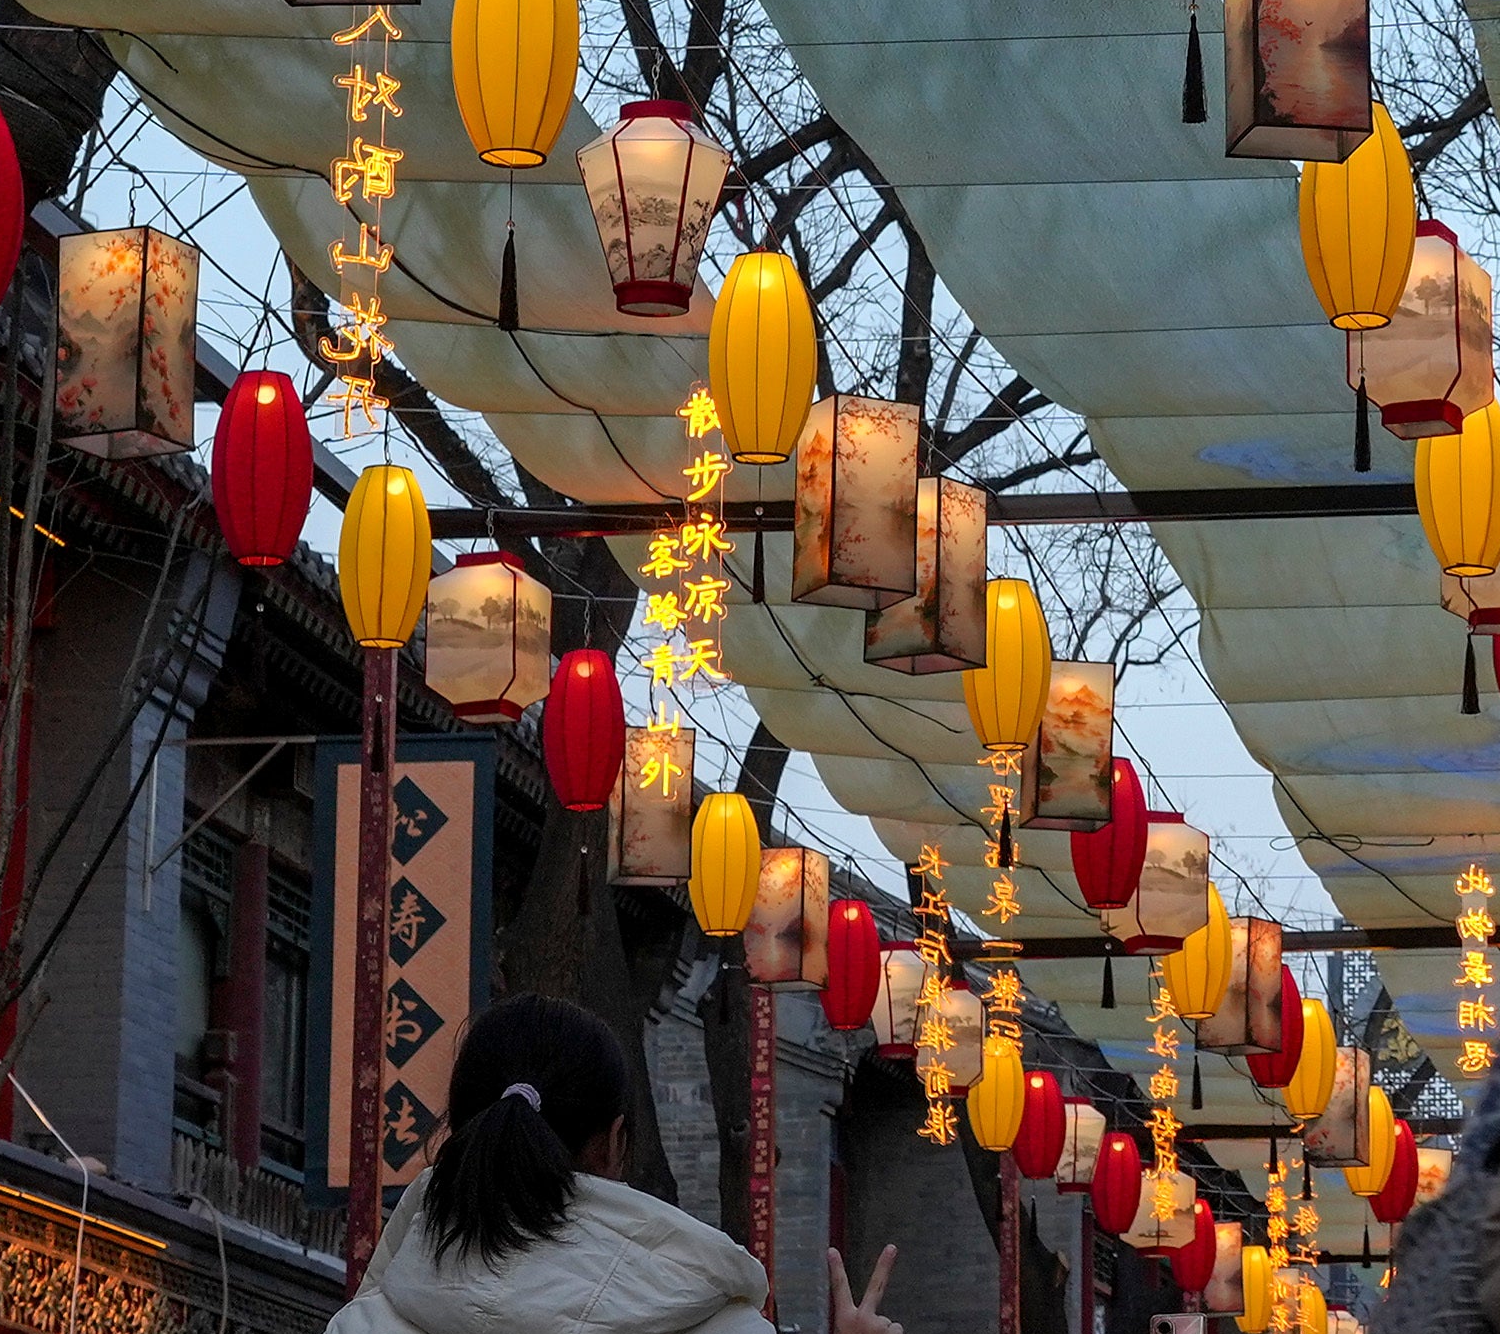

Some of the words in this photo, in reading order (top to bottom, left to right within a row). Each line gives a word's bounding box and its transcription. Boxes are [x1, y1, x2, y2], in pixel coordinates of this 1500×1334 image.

[639, 532, 690, 798] 客路青山外
